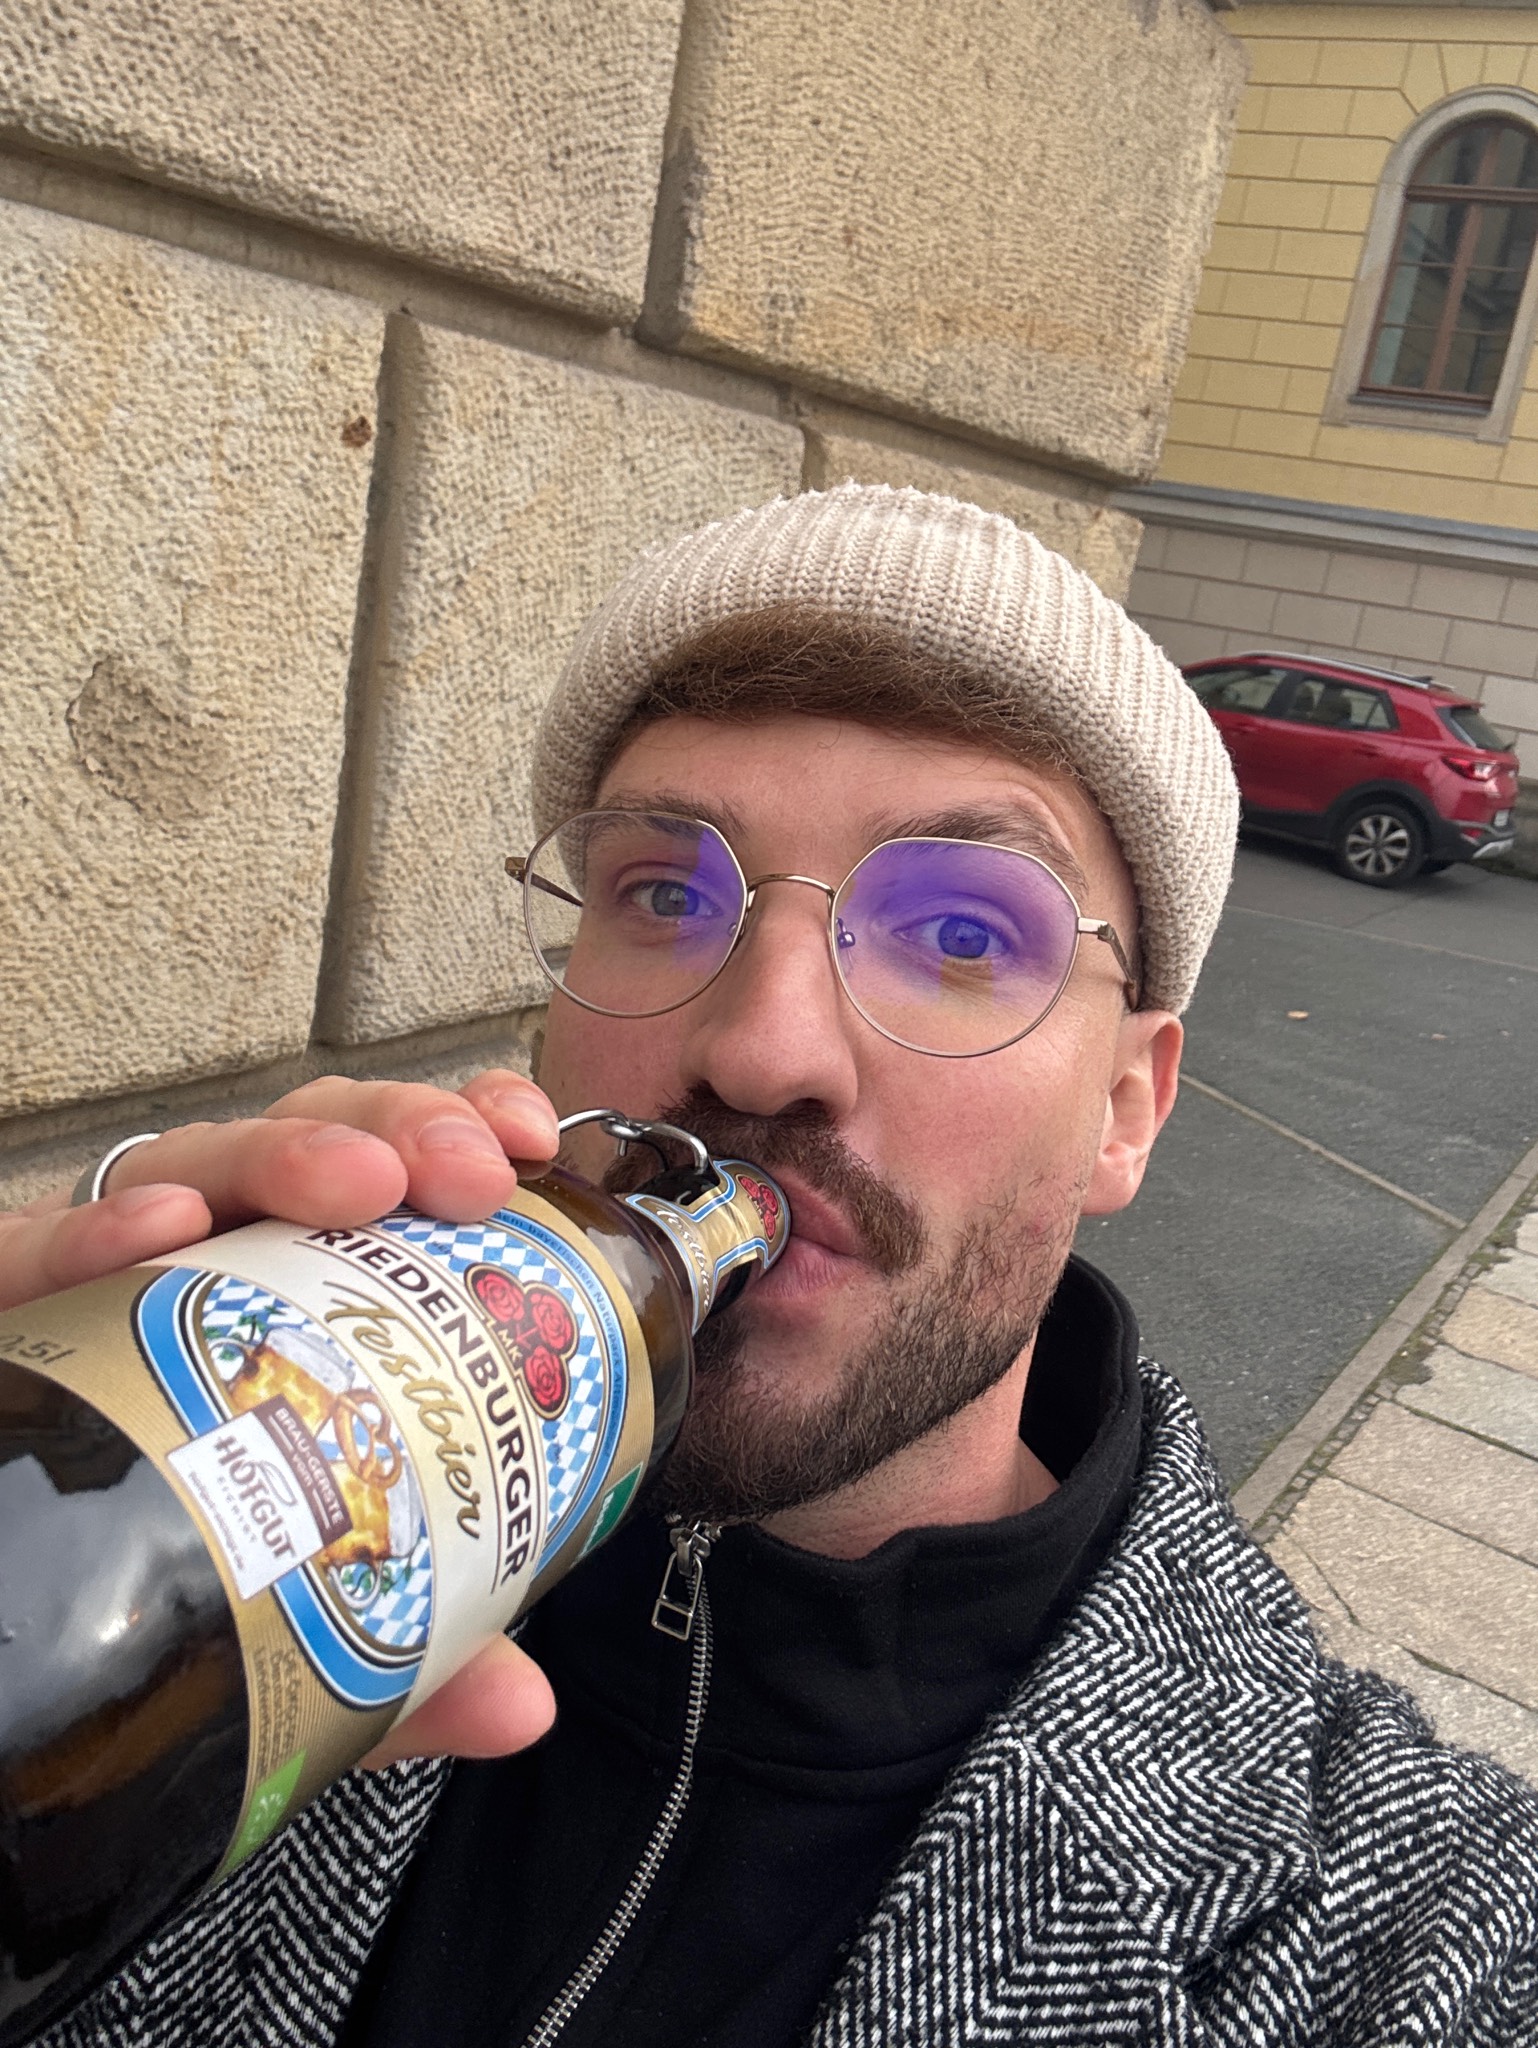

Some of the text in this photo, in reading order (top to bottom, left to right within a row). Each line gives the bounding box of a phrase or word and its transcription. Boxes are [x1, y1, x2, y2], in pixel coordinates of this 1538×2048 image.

[275, 1407, 344, 1524] BRAU-GERSTE
[306, 1229, 534, 1583] RIEDENBURGER
[322, 1281, 481, 1540] Festbier
[213, 1435, 296, 1560] HOFGUT
[290, 1452, 313, 1488] vom
